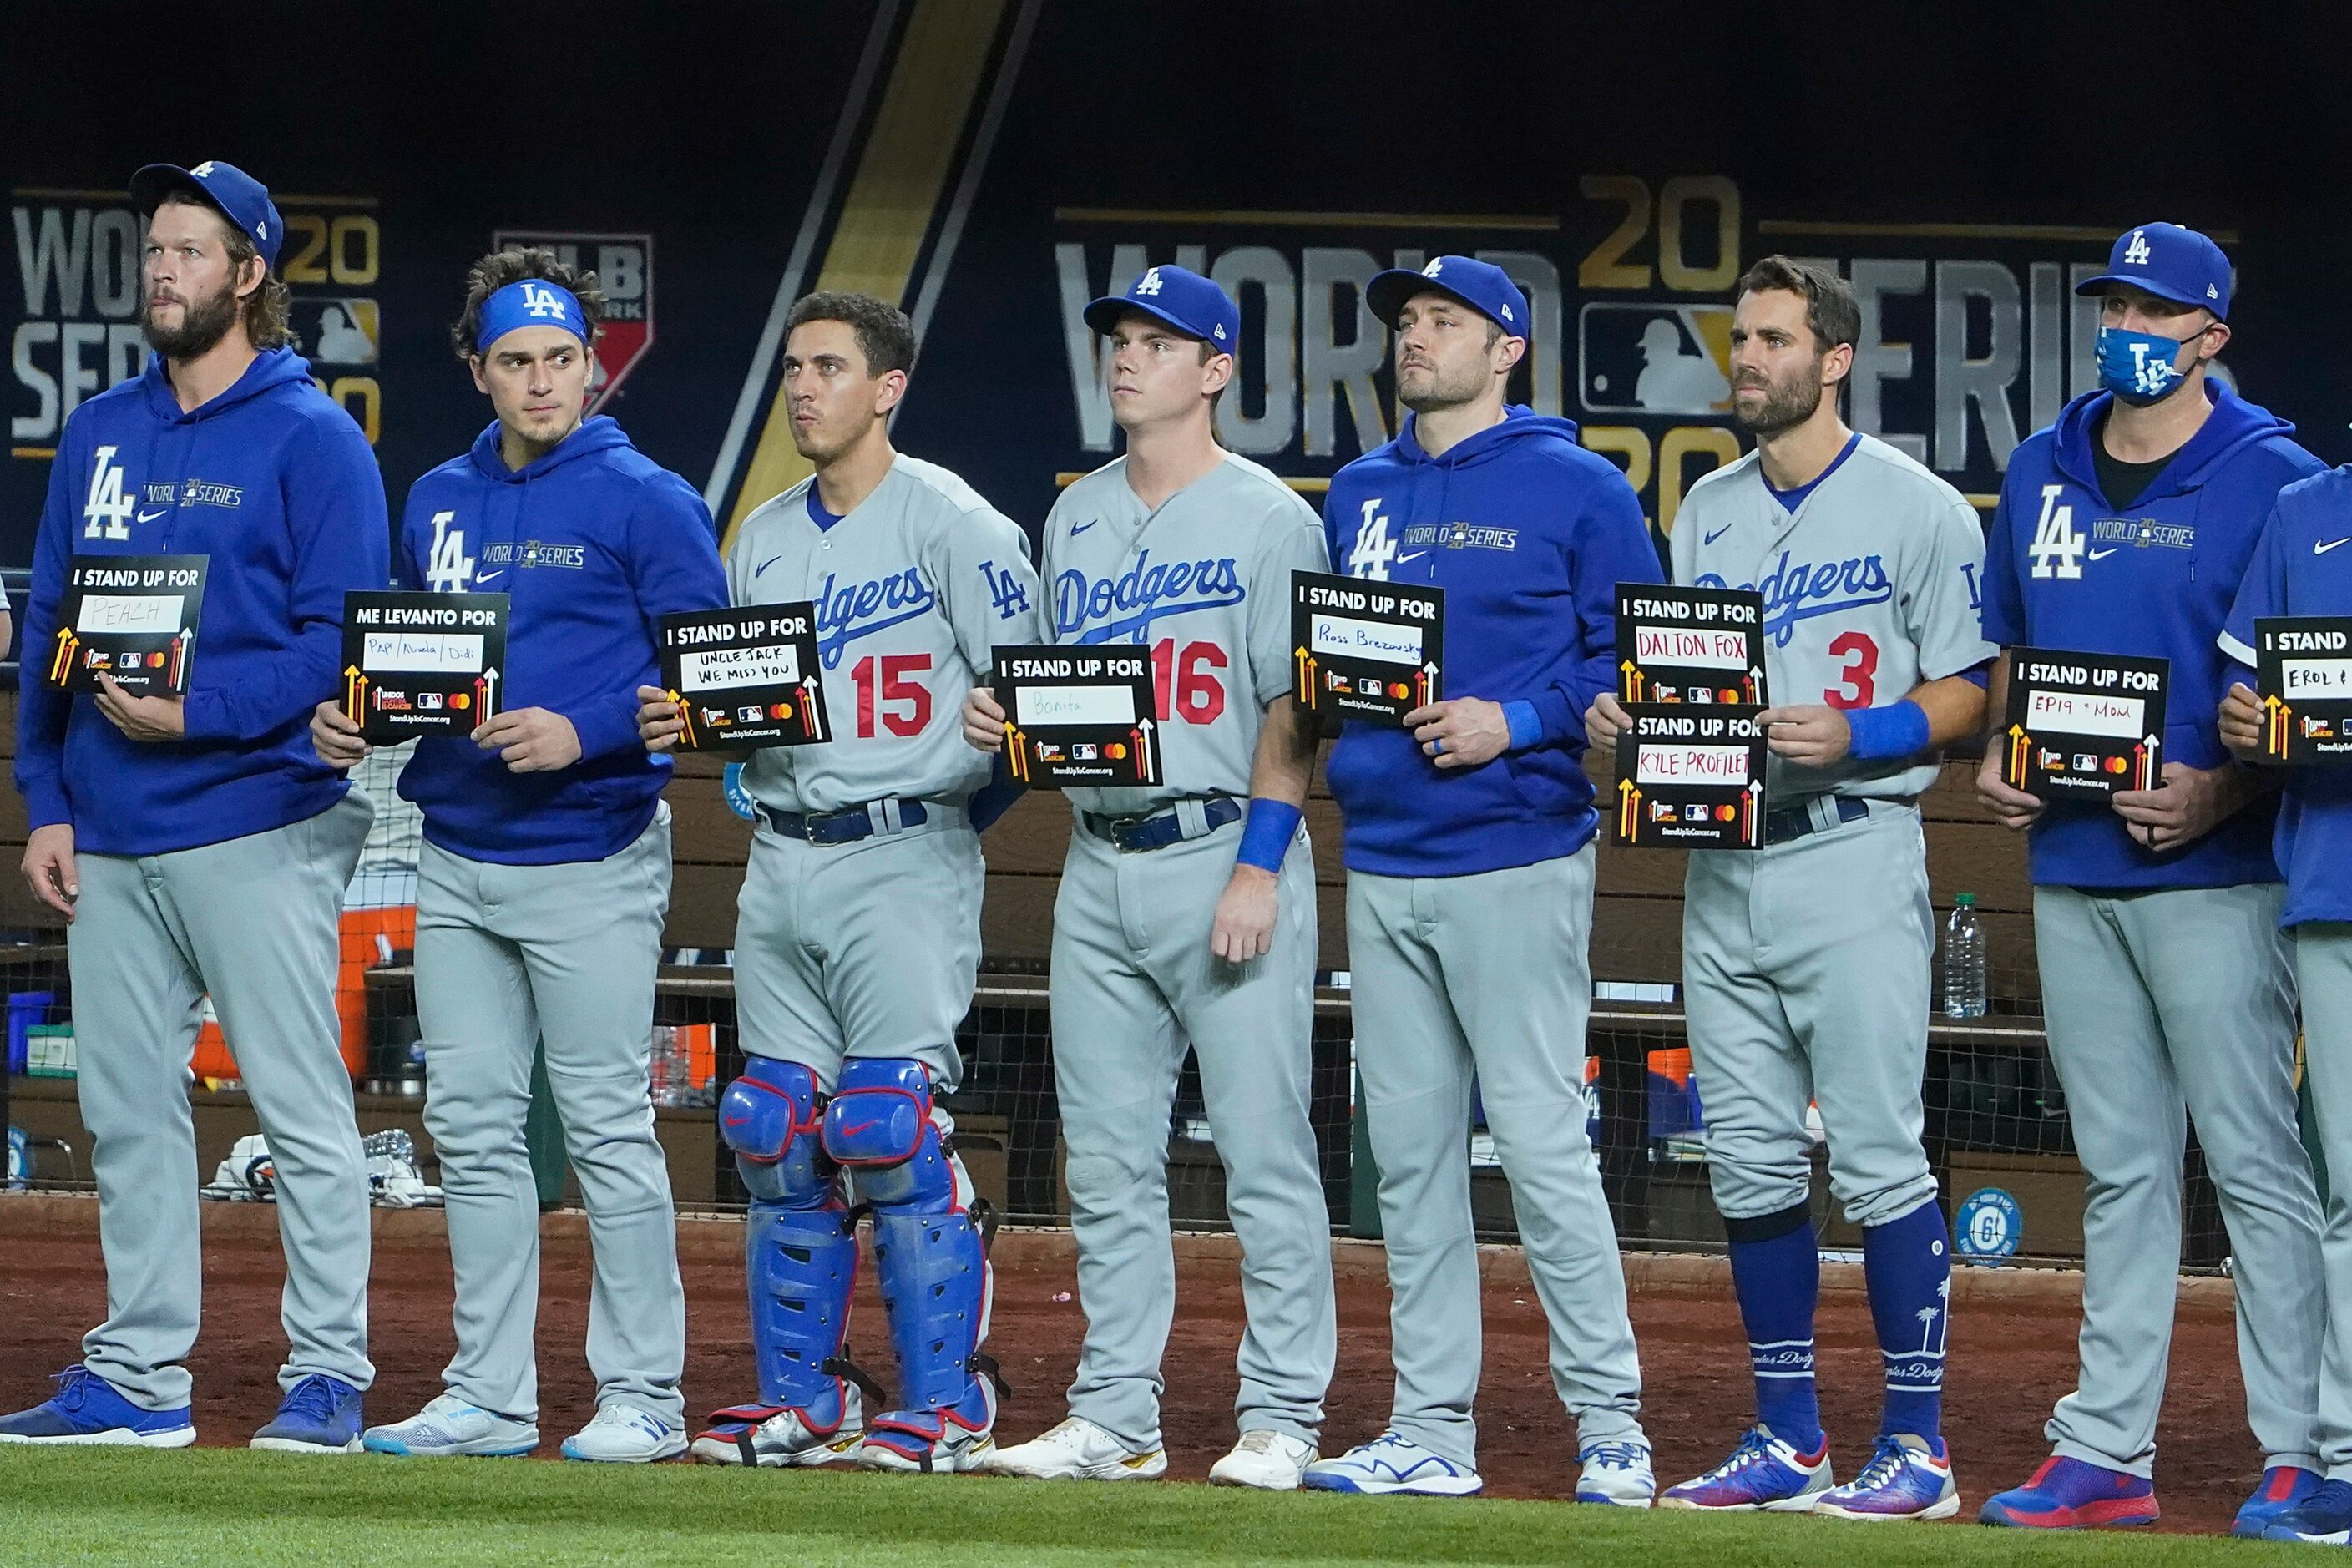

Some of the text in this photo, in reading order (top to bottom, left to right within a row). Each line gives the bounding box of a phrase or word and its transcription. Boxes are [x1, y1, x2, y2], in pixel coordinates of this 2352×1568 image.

[1578, 175, 1741, 291] 20
[284, 215, 378, 284] 20
[2125, 230, 2151, 265] LA
[1136, 267, 1162, 296] LA
[520, 283, 566, 321] LA
[84, 445, 135, 540] LA
[196, 486, 244, 506] SERIES
[1348, 499, 1398, 581] LA
[1404, 527, 1518, 549] WORLD SERIES
[2029, 484, 2086, 579] LA
[2092, 521, 2138, 540] WORLD
[427, 511, 476, 593] LA
[483, 545, 584, 566] WORLD SERIES
[73, 569, 199, 587] I STAND UP FOR
[978, 560, 1030, 620] LA
[1056, 549, 1246, 645] Dodgers
[1299, 586, 1436, 620] I STAND UP FOR
[92, 597, 160, 625] PEACH
[356, 609, 496, 625] ME LEVANTO POR
[813, 567, 935, 670] dgers
[1622, 599, 1756, 624] I STAND UP FOR
[667, 617, 807, 645] I STAND UP FOR
[1319, 624, 1348, 644] Ross
[2265, 632, 2347, 650] I STAND
[701, 647, 783, 665] UNCLE JACK
[1638, 632, 1745, 660] DALTON FOX
[698, 670, 721, 683] WE
[727, 668, 756, 680] MISS
[1001, 659, 1145, 678] I STAND UP FOR
[1823, 631, 1879, 709] 3
[2018, 662, 2159, 691] I STAND UP FOR
[2289, 670, 2332, 688] EROL
[1151, 638, 1228, 725] 16
[851, 653, 933, 738] 15
[1033, 690, 1083, 716] Bonita
[1338, 697, 1396, 715] StandUpToCancer.org
[389, 715, 451, 726] StandUpToCancer.org
[1638, 717, 1762, 736] STAND UP FOR
[719, 728, 781, 740] StandUpToCancer.org
[1052, 766, 1114, 776] StandUpToCancer.org
[1640, 751, 1680, 776] KYLE
[2049, 775, 2110, 791] StandUpToCancer.org
[1662, 827, 1721, 838] StandUpToCancer.org
